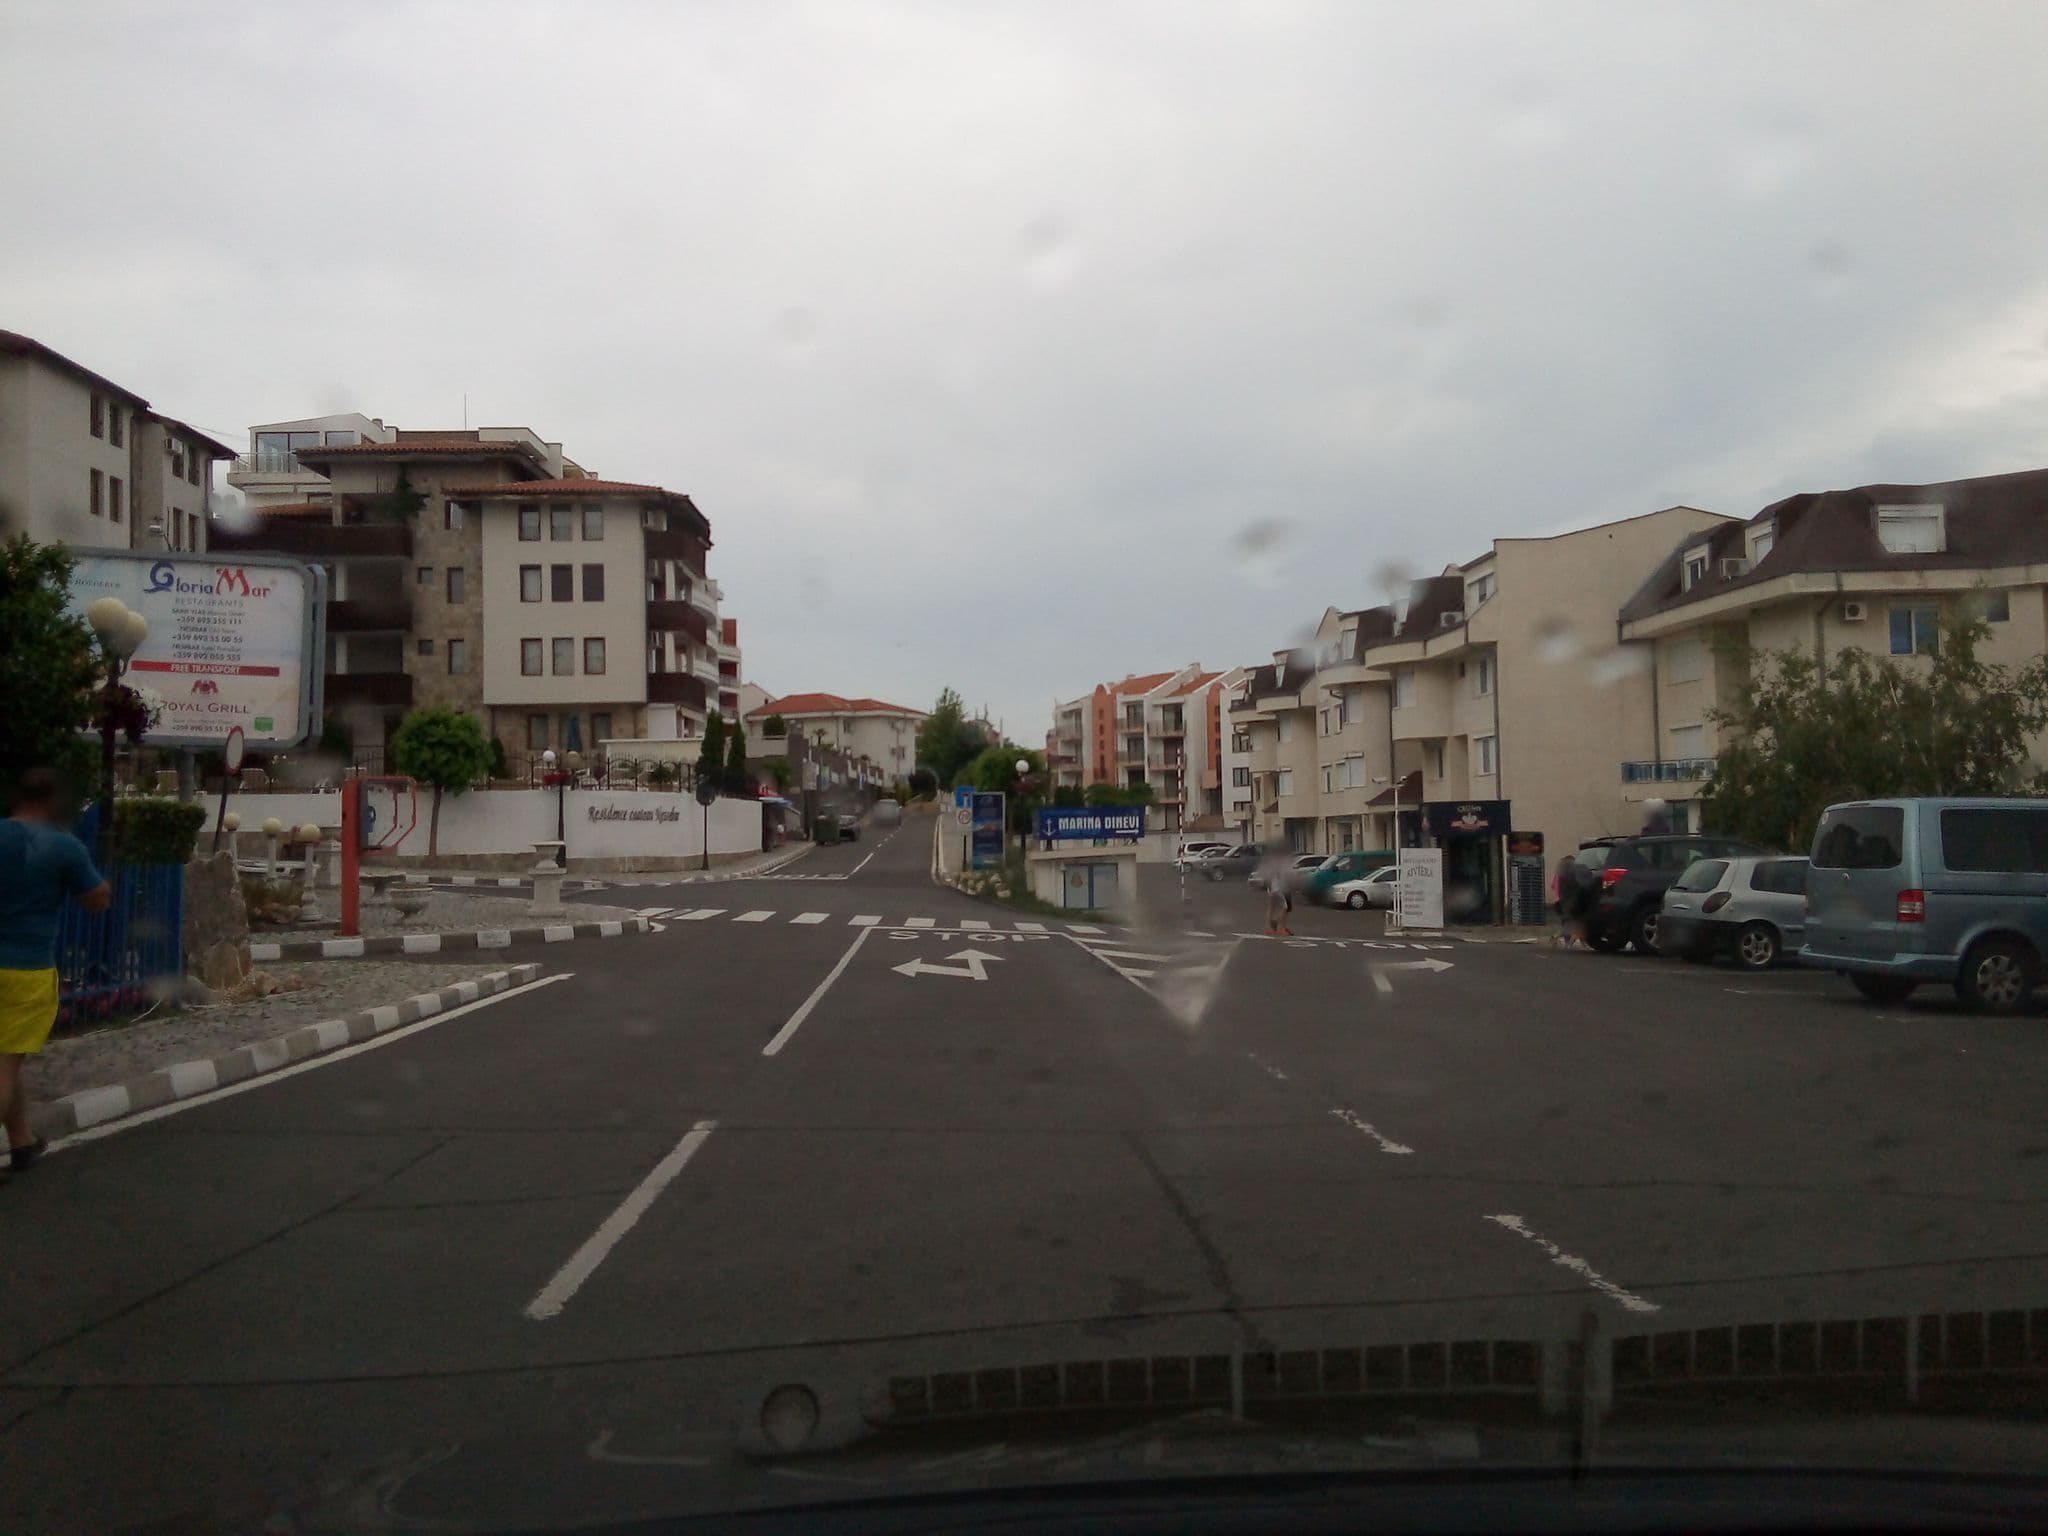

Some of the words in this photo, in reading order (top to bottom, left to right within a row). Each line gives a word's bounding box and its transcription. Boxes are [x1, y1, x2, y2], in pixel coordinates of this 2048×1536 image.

[143, 561, 213, 594] Gloria
[216, 566, 271, 597] Mar
[170, 663, 189, 672] FREE
[192, 664, 240, 675] TRANSPORT
[208, 702, 251, 714] GRILL
[1058, 816, 1101, 831] MARINA
[888, 930, 1051, 942] STOP
